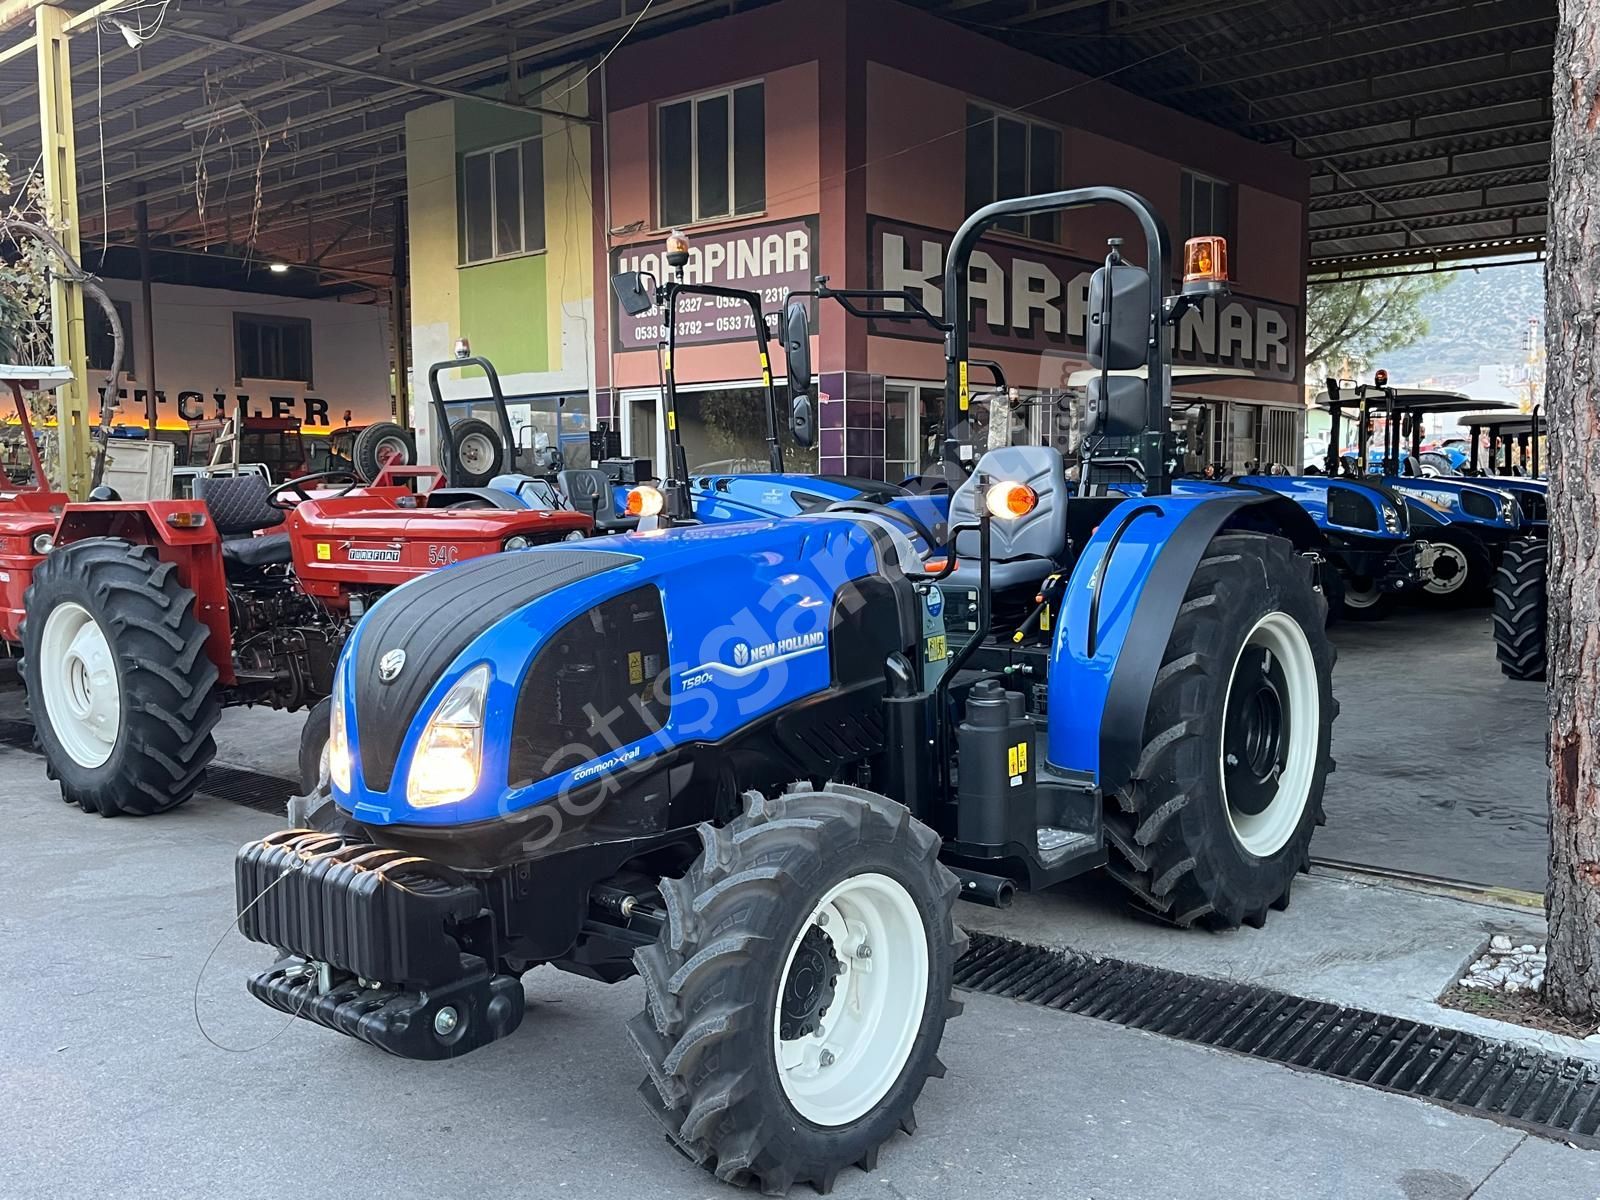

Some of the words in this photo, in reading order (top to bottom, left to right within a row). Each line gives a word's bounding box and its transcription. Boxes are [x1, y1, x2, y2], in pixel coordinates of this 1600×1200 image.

[679, 297, 702, 313] 2327
[635, 325, 658, 340] 0533
[679, 321, 702, 336] 3792
[716, 317, 741, 331] 0533
[428, 545, 459, 565] 54C
[750, 646, 776, 662] NEW
[777, 631, 824, 653] HOLLAND
